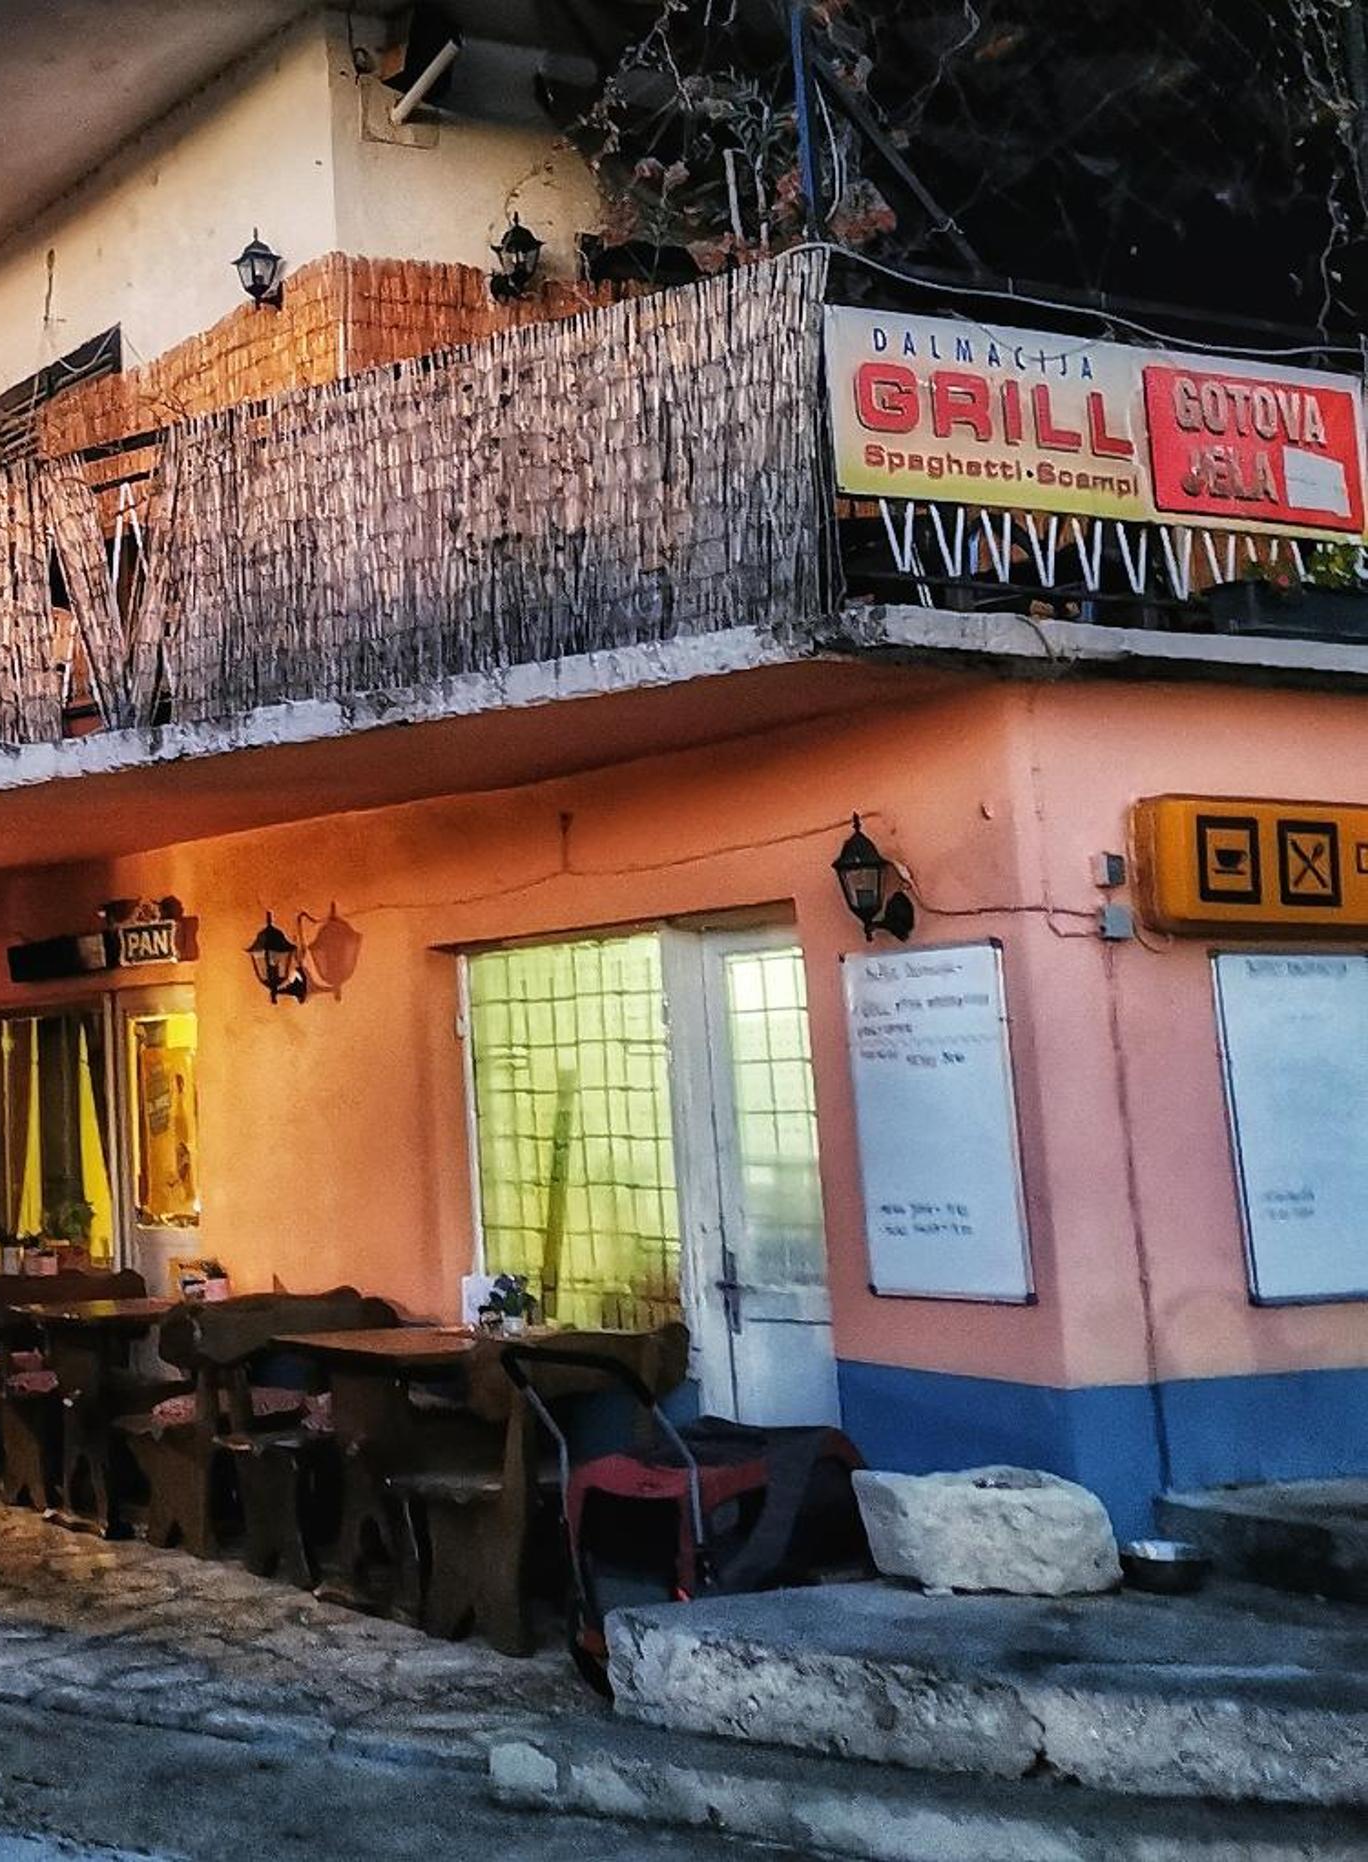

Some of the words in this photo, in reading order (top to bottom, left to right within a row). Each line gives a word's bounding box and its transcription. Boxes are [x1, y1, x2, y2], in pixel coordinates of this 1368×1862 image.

[871, 326, 1094, 381] DALMACIJA
[853, 361, 1136, 461] GRILL
[1173, 375, 1328, 448] GOTOVA
[863, 443, 1022, 481] Spaghetti
[1035, 460, 1139, 497] Scampi
[1182, 445, 1280, 505] JELA
[126, 929, 170, 957] PAN
